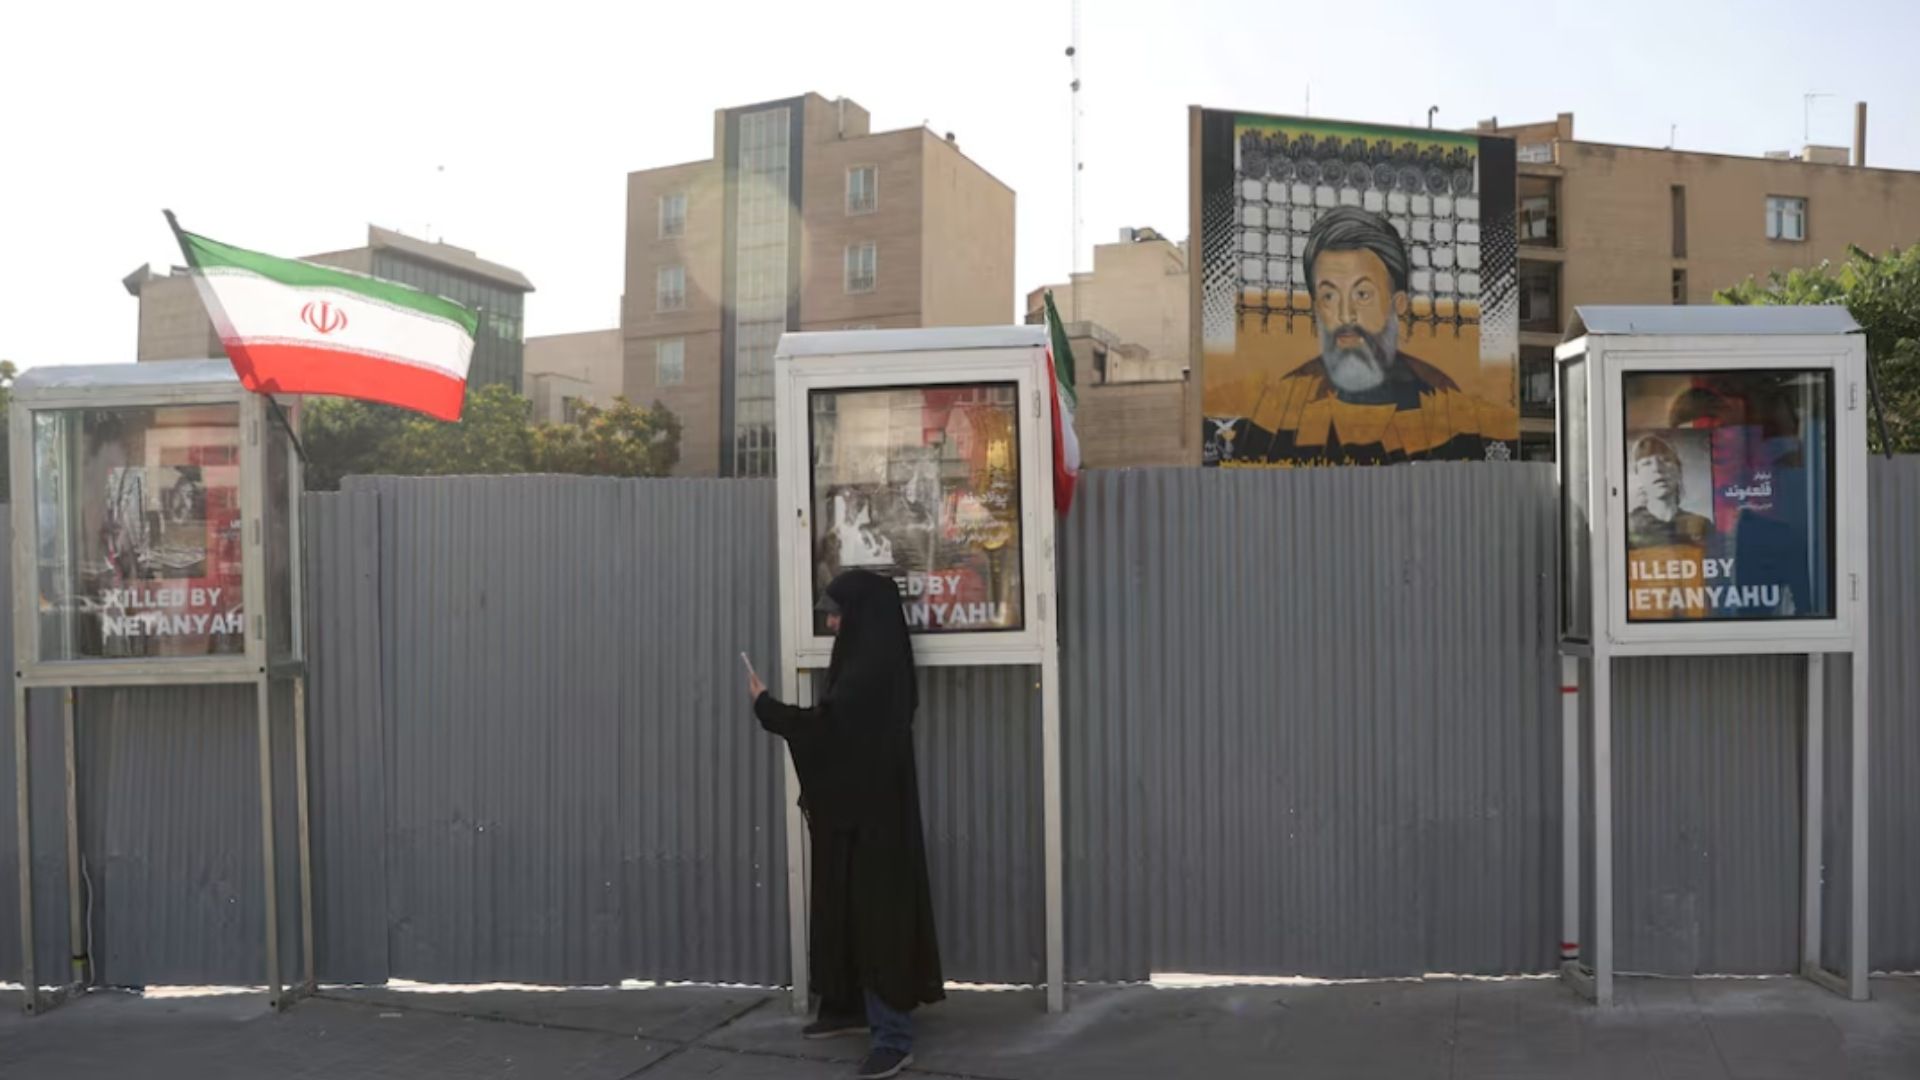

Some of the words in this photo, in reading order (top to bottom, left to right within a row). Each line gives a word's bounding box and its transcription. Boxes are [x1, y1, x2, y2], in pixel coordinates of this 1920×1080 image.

[1630, 559, 1698, 581] ILLED
[1702, 558, 1735, 578] BY
[191, 587, 222, 607] BY
[928, 575, 961, 596] BY
[103, 612, 244, 637] NETANYAH
[902, 602, 1007, 627] NYAHU
